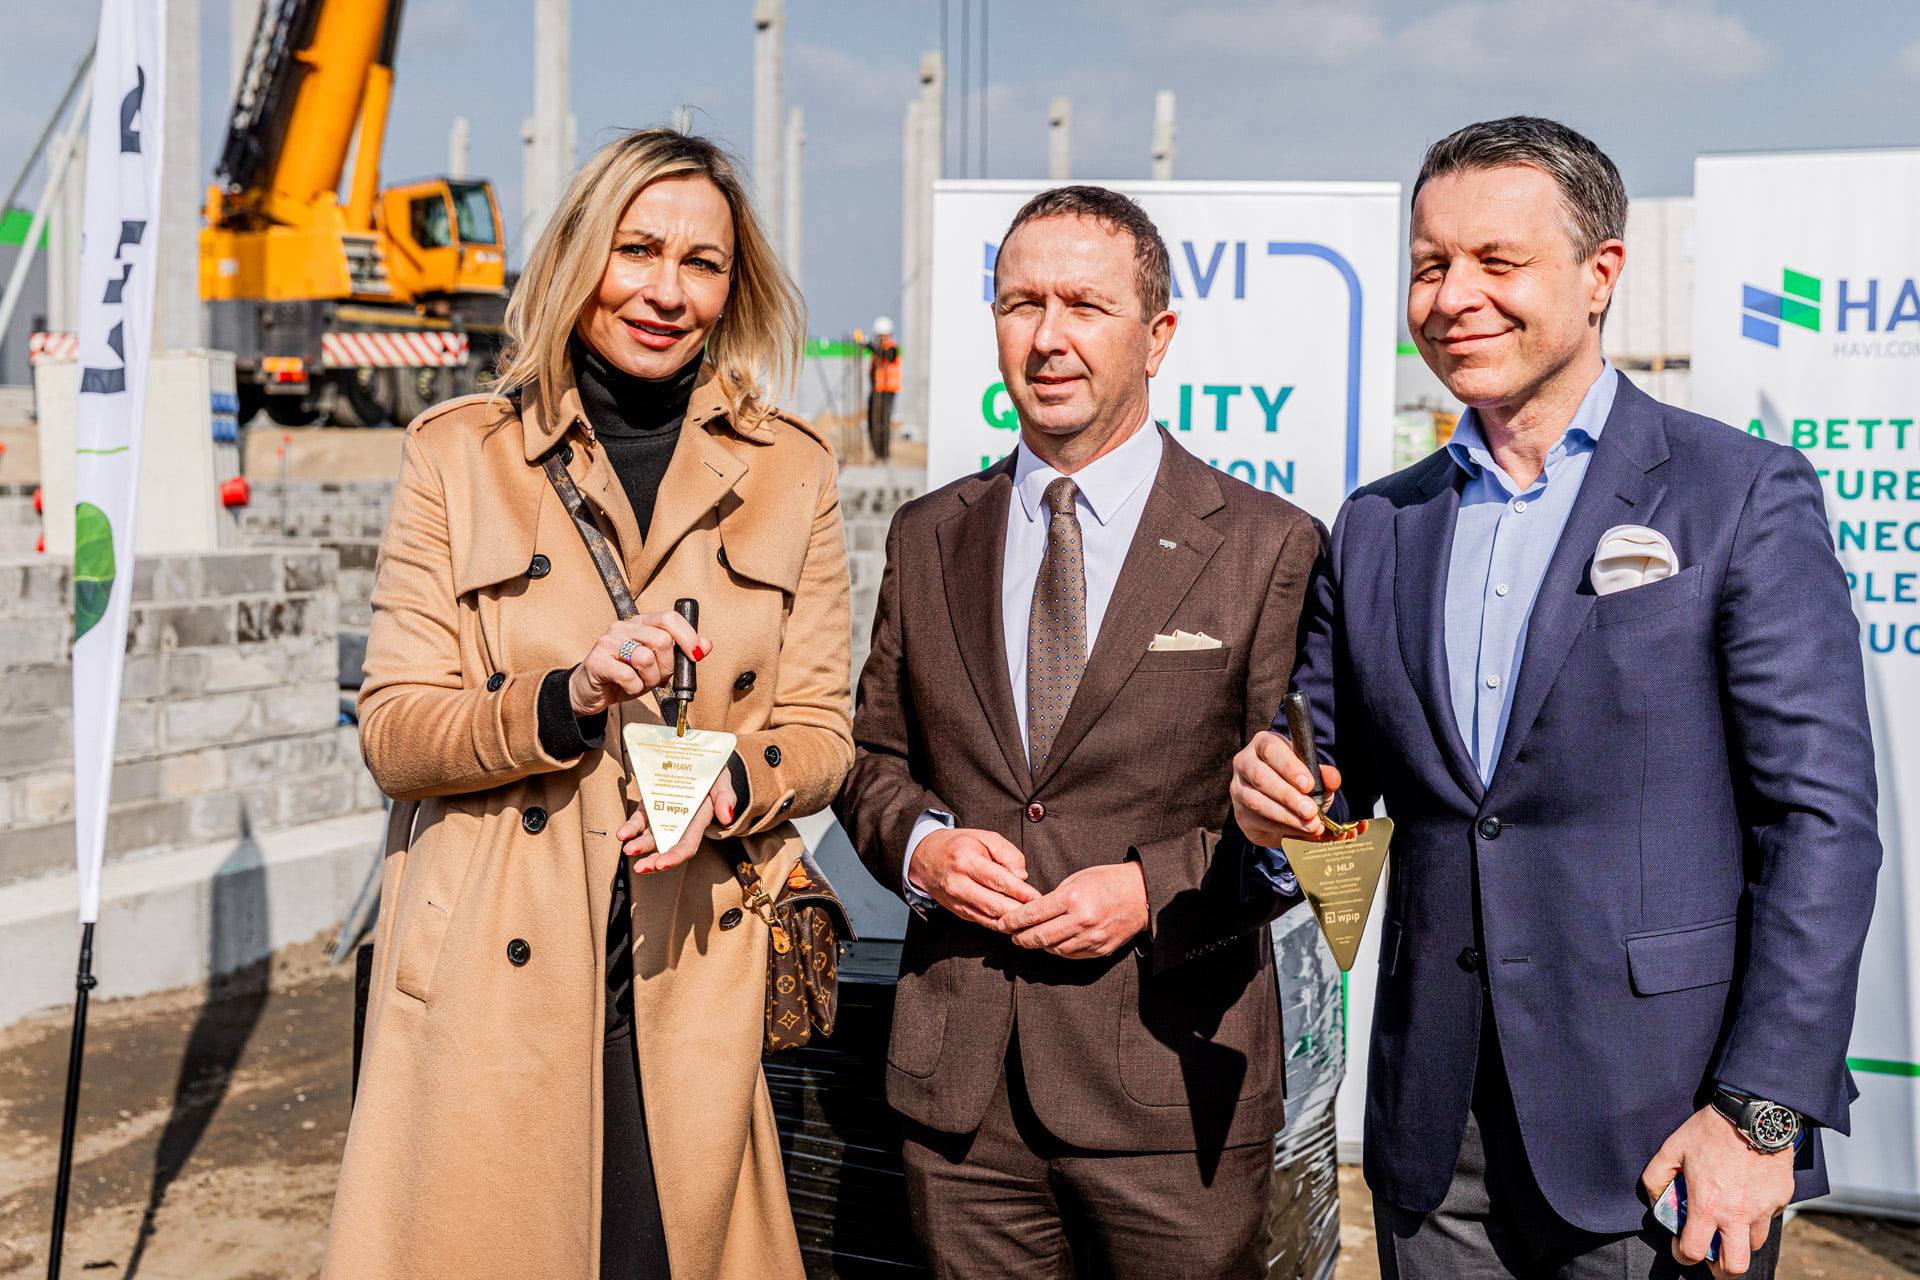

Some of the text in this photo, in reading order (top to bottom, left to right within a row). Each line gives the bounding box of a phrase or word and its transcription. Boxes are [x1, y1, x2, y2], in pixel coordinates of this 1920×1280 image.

[1171, 241, 1246, 299] VI
[982, 382, 1295, 432] QITY
[1828, 520, 1920, 551] NEC
[673, 763, 693, 771] HAVI
[667, 805, 689, 815] wpip
[1336, 862, 1355, 872] MLP
[1337, 912, 1360, 924] wpip
